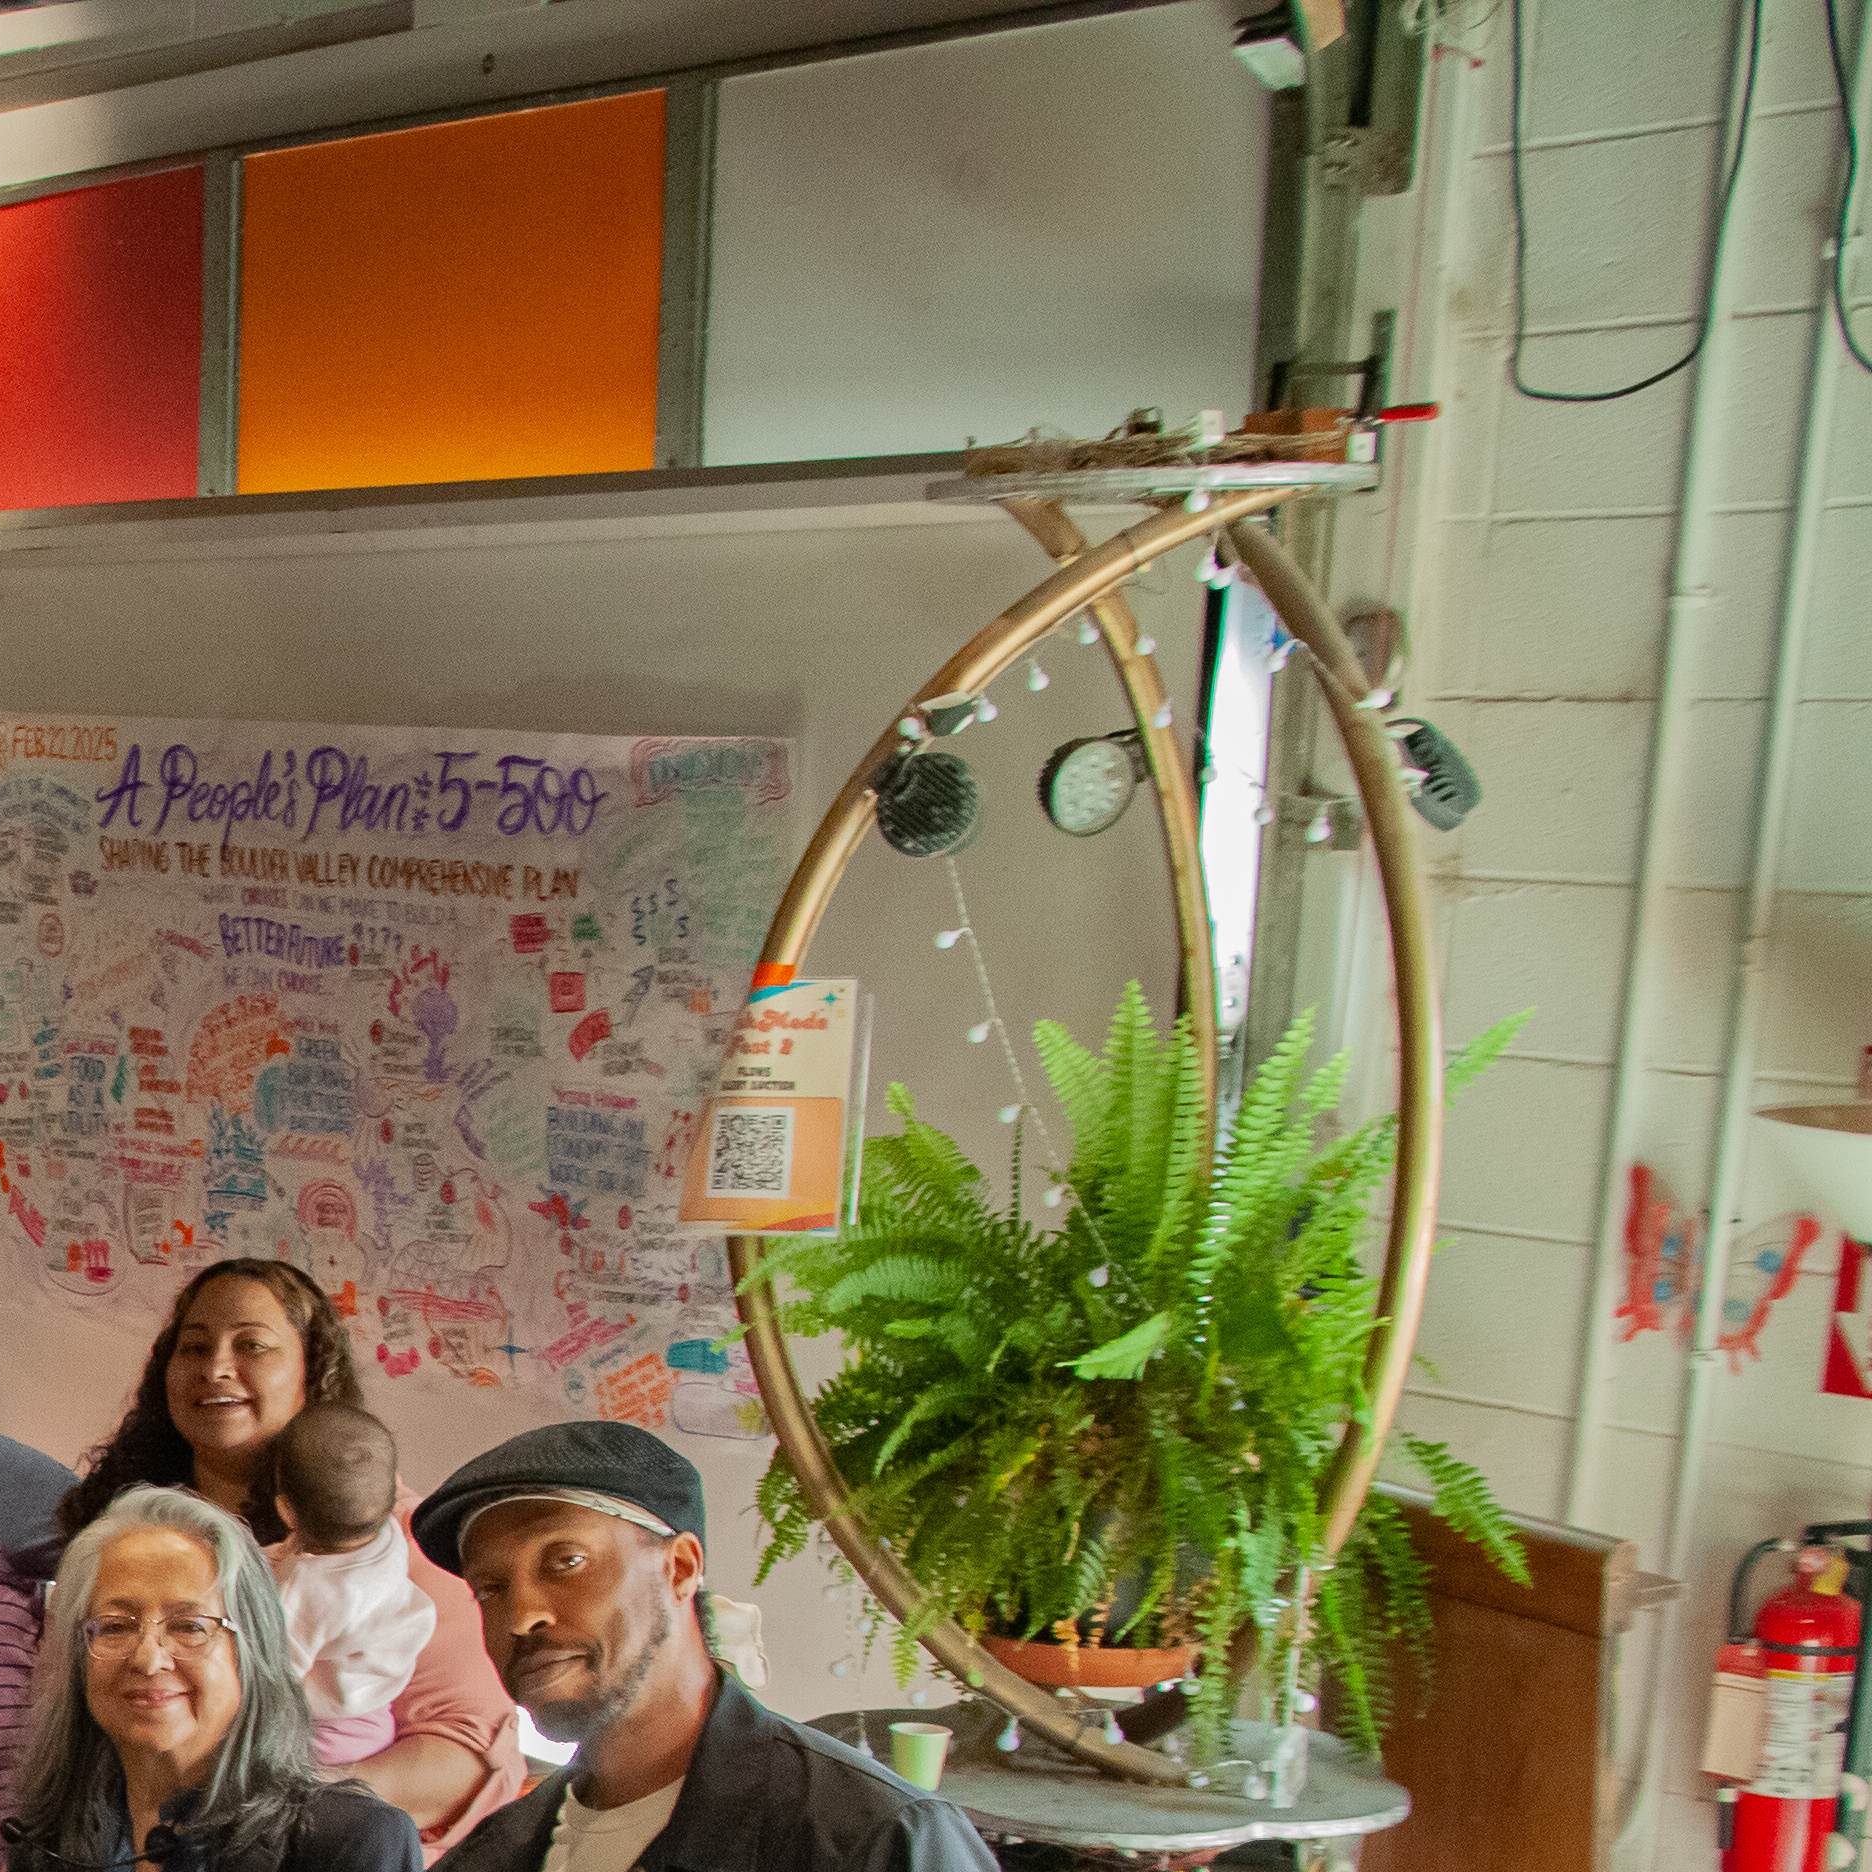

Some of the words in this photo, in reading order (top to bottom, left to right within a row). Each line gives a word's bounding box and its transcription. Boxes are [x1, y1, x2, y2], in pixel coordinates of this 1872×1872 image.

[72, 726, 118, 762] 2025
[94, 743, 153, 829] A
[152, 743, 302, 844] People's
[435, 750, 609, 836] 5-500
[100, 835, 171, 875] SHAPING
[175, 842, 211, 878] THE
[219, 845, 291, 884] BOULDER
[293, 850, 359, 889] VALLEY
[367, 855, 513, 901] COMPREHENSIVE
[521, 864, 580, 902] PLAN
[219, 913, 287, 959] BETTER
[287, 922, 346, 966] FUTURE
